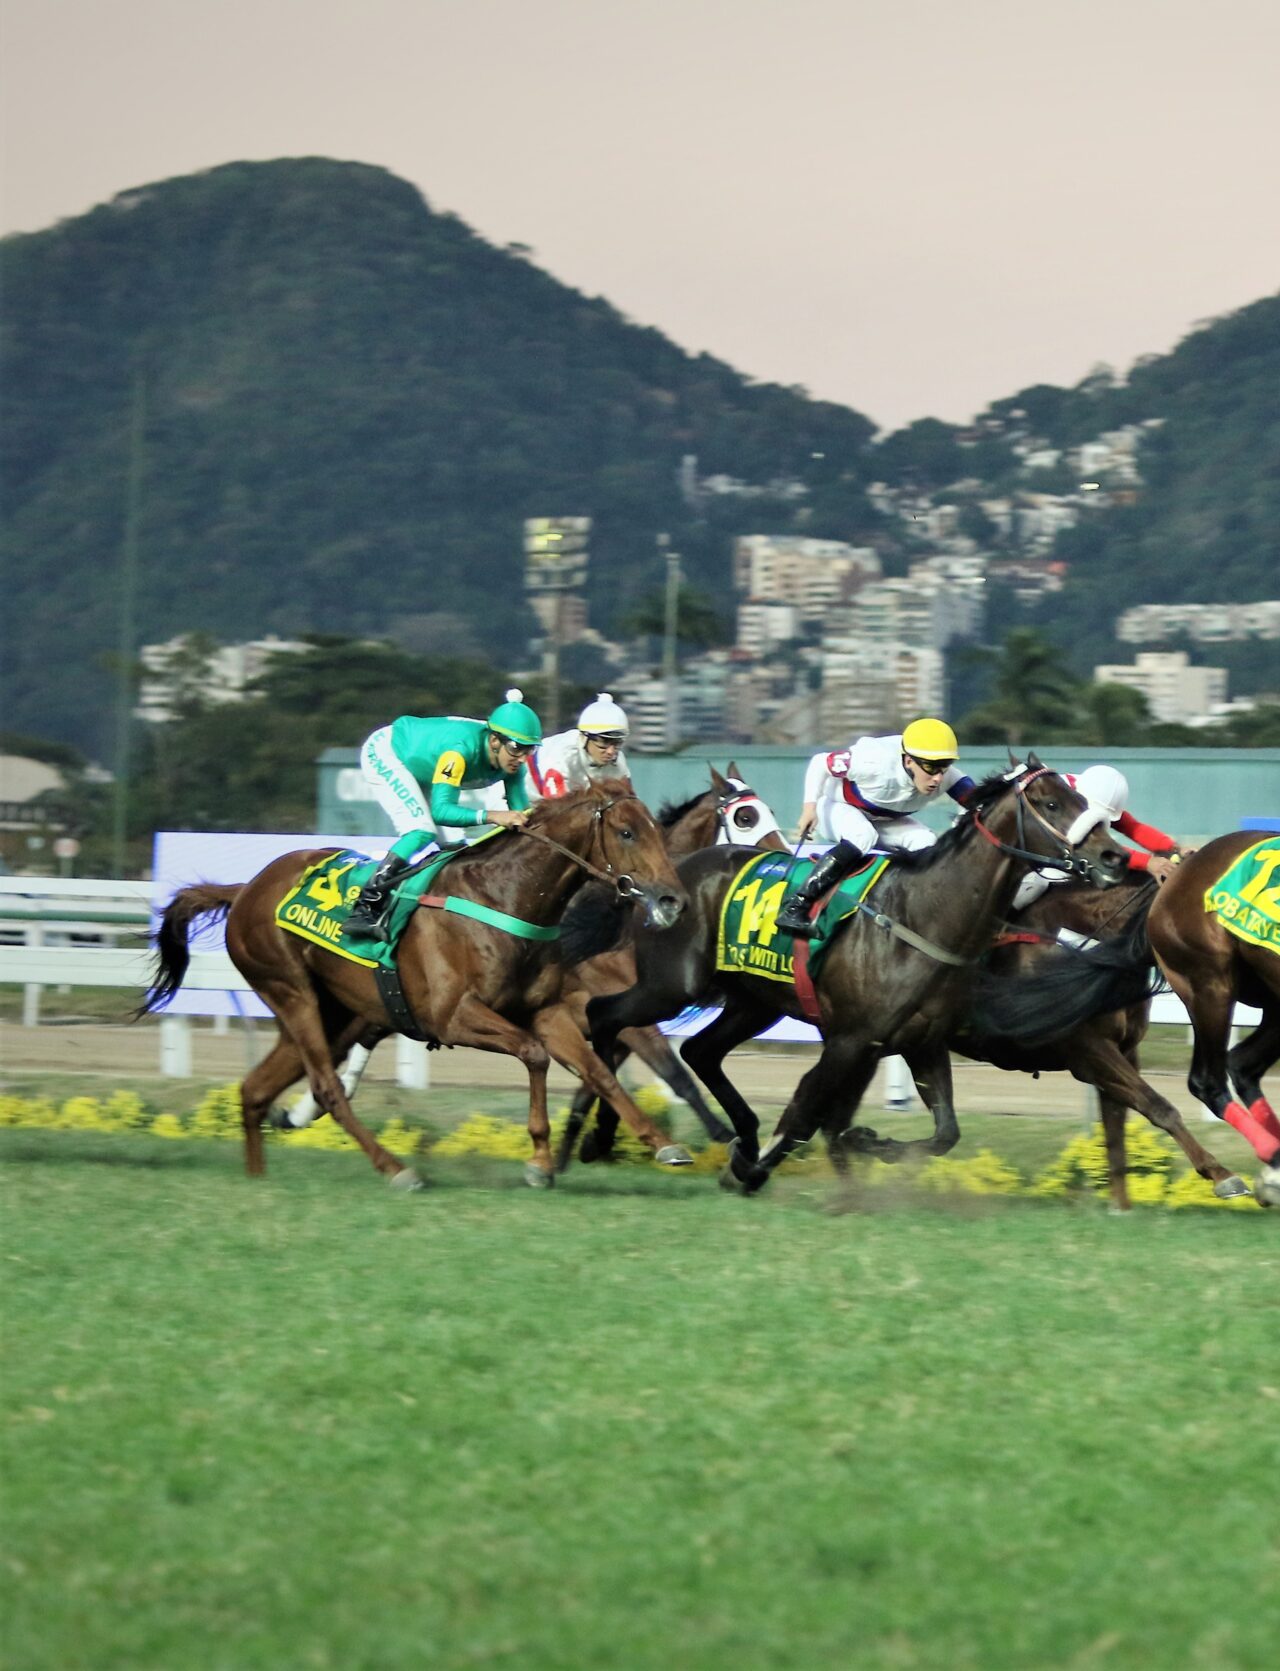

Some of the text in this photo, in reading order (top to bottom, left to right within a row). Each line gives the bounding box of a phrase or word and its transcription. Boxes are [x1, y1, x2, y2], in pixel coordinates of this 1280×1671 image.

[441, 762, 455, 779] 4
[285, 904, 343, 943] ONLINE
[732, 878, 788, 947] 14
[749, 945, 778, 971] WITH
